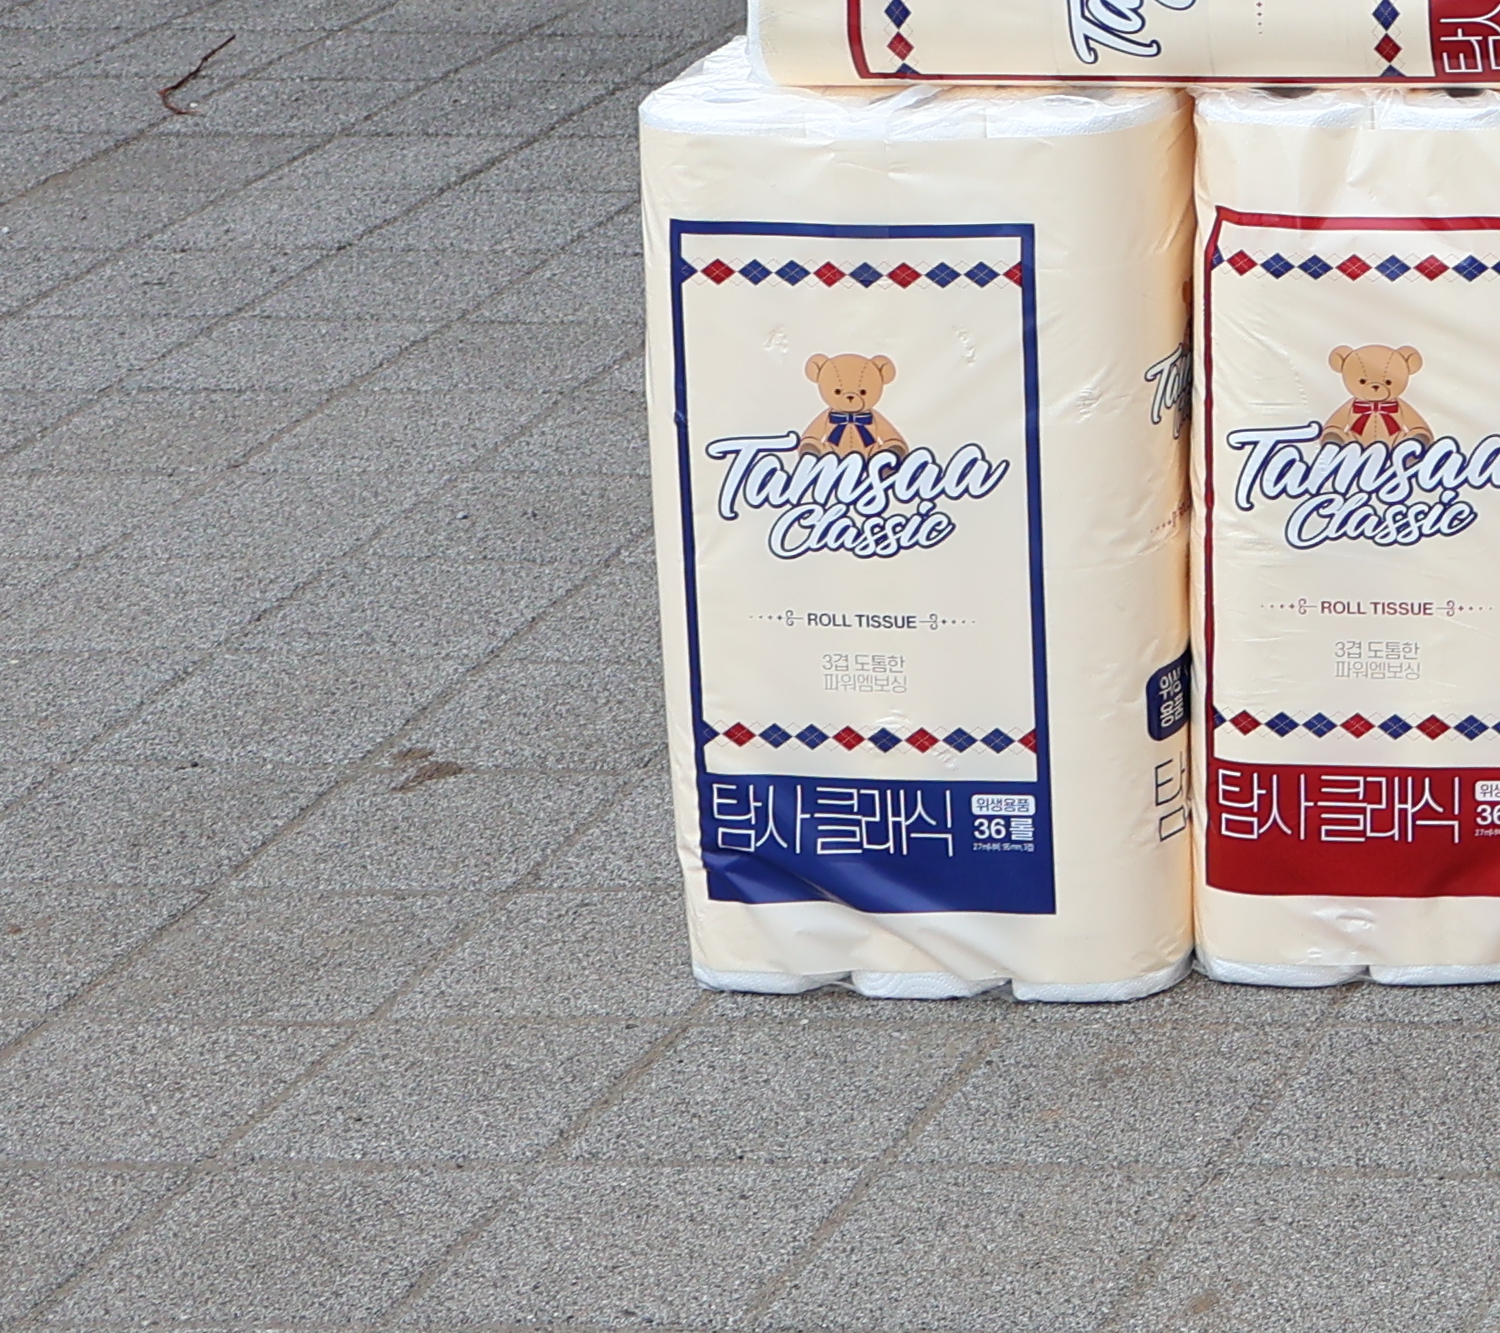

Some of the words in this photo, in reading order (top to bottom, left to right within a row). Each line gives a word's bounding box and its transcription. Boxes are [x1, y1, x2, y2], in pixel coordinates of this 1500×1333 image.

[706, 432, 1008, 523] Tamsaa
[1286, 489, 1477, 549] Classic
[769, 502, 956, 560] Classic
[1321, 600, 1366, 617] ROLL
[1369, 601, 1434, 618] TISSUE
[807, 612, 853, 629] ROLL
[856, 613, 917, 630] TISSUE
[1335, 641, 1362, 661] 3겹
[1367, 641, 1420, 662] 도톰한
[822, 653, 849, 675] 3겹
[854, 654, 906, 675] 도톰한
[1334, 661, 1421, 681] 파워엠보싱
[823, 674, 907, 695] 파워엠보싱
[975, 798, 1031, 813] 위생용품
